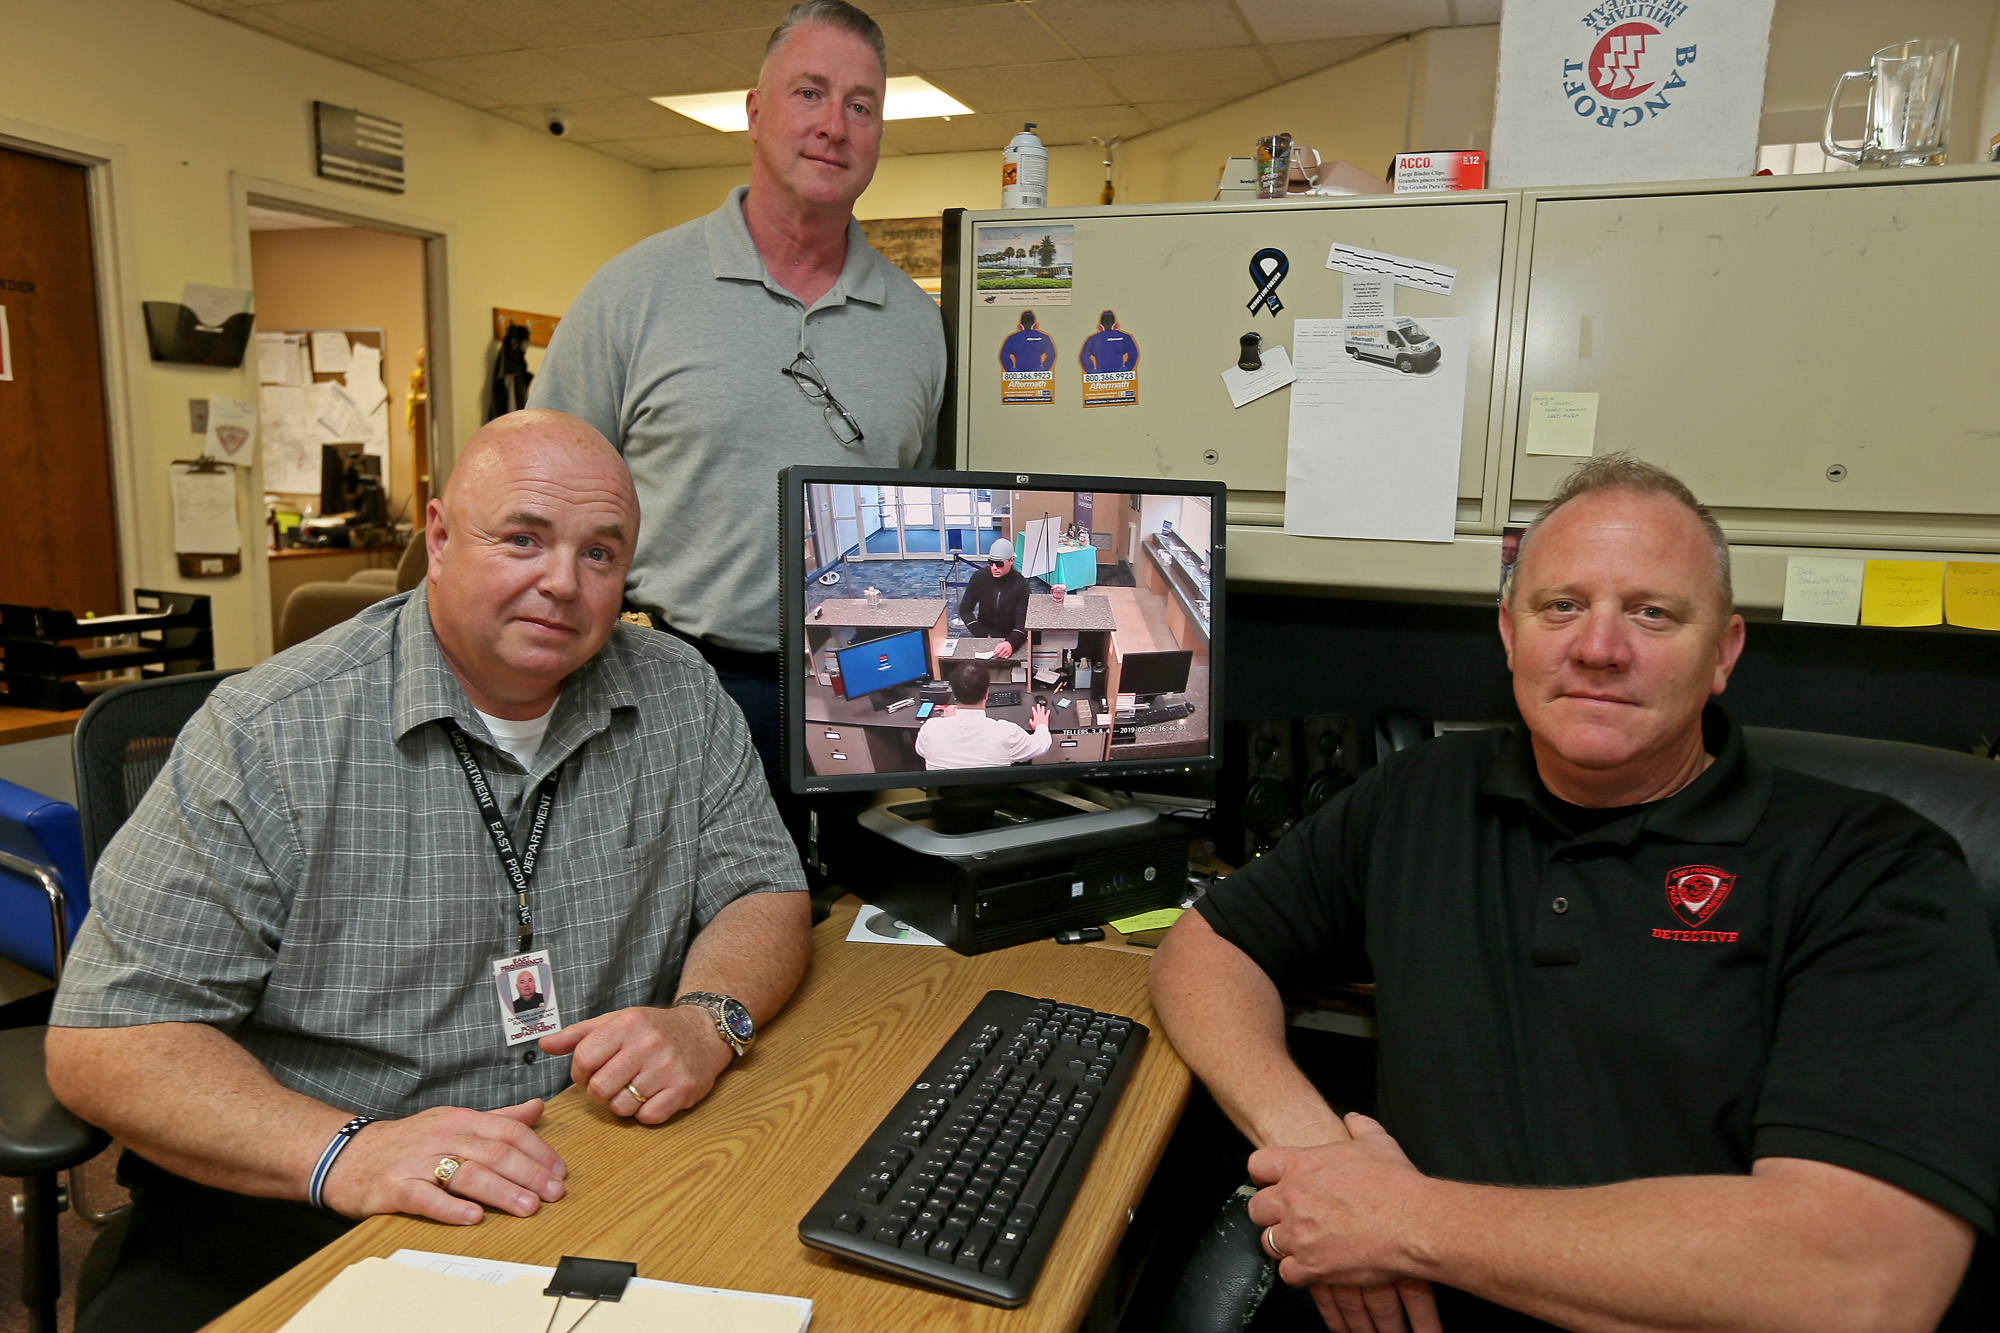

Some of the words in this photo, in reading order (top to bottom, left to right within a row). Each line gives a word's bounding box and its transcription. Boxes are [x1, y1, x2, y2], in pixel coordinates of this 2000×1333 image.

[1592, 4, 1676, 36] MILITARY
[1563, 44, 1696, 128] BANCROFT
[1400, 156, 1431, 169] ACCO
[1085, 372, 1134, 382] 800.366.9923
[1089, 381, 1130, 390] Aftermath
[451, 730, 494, 809] DEPARTMENT
[491, 821, 512, 853] EAST
[523, 793, 553, 874] DEPARTMENT
[1651, 928, 1739, 942] DETECTIVE
[500, 958, 543, 972] PROVIDENCE
[513, 955, 530, 964] EAST
[511, 1024, 556, 1040] DEPARTMENT
[521, 1022, 544, 1031] POLICE
